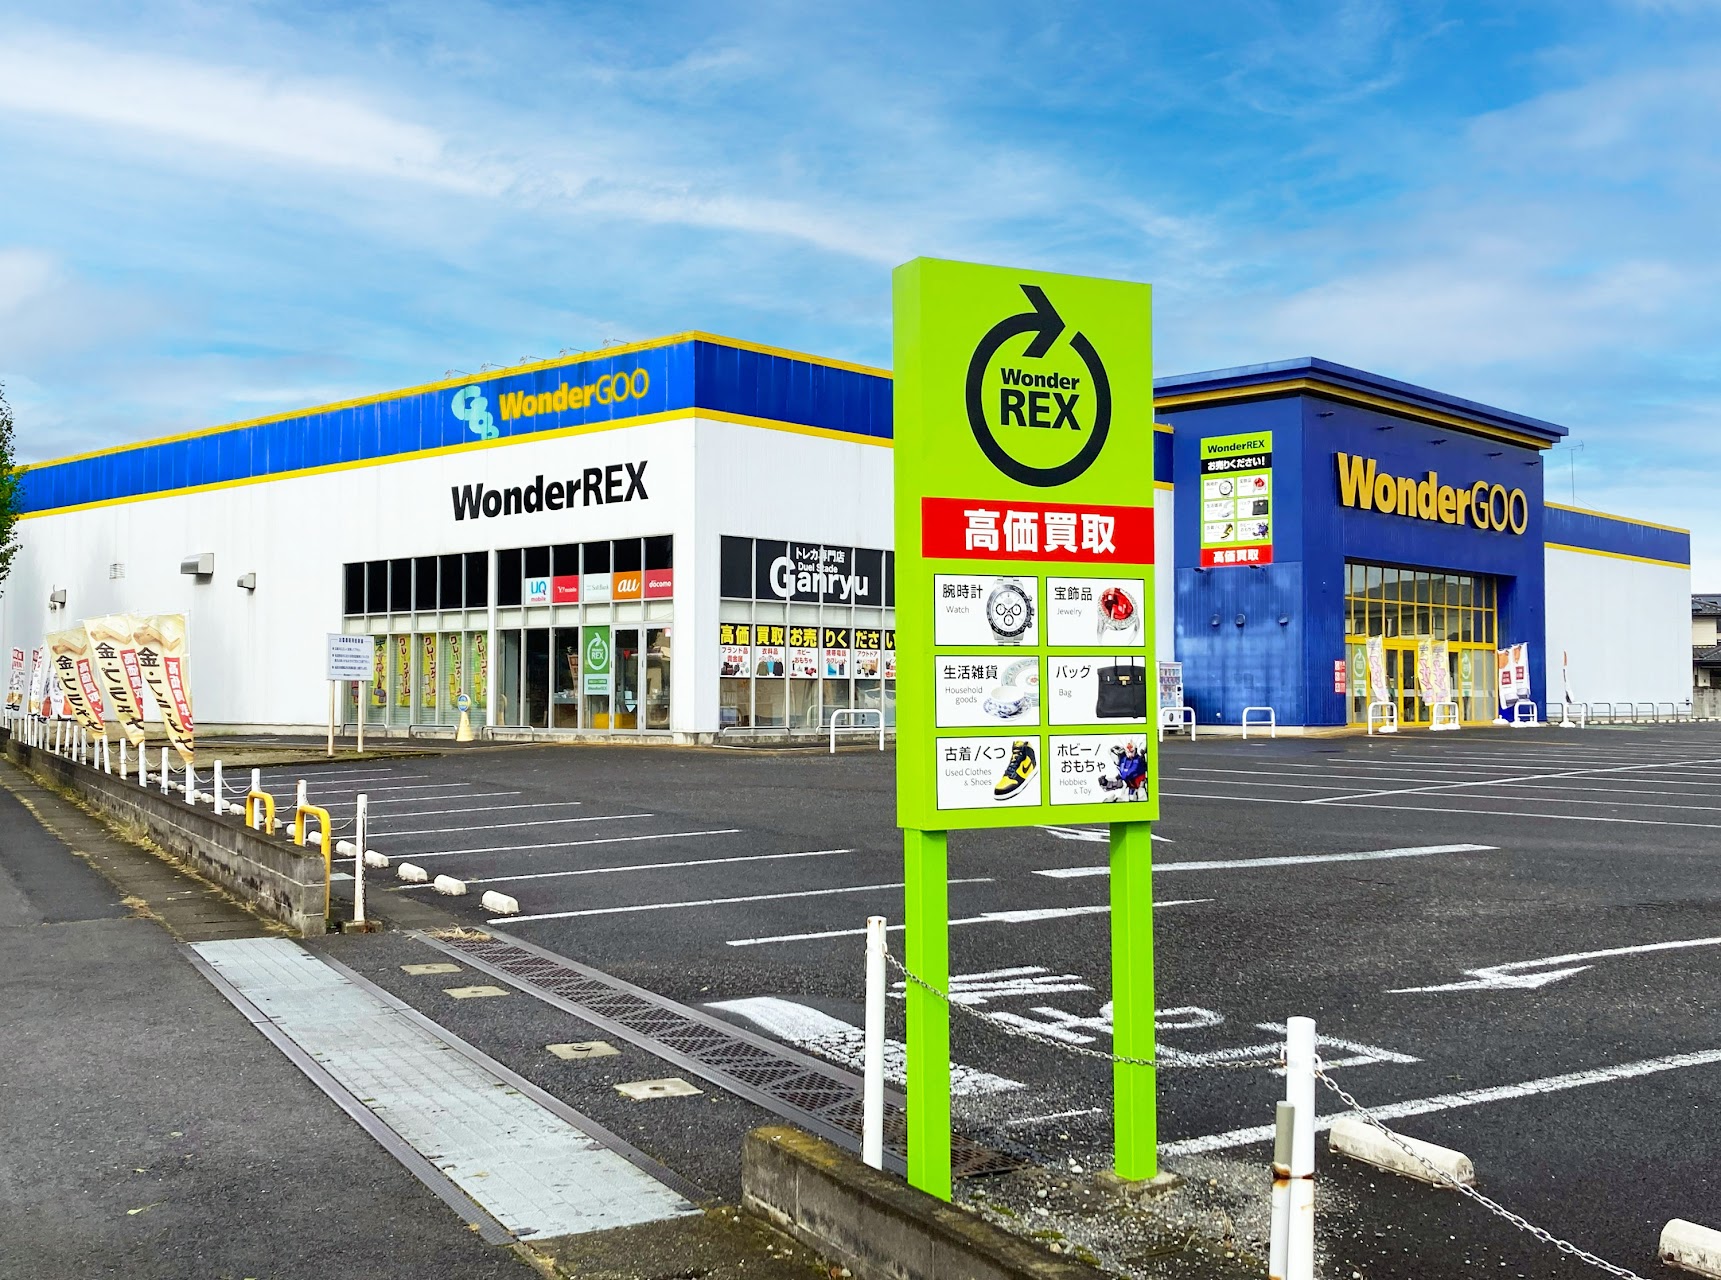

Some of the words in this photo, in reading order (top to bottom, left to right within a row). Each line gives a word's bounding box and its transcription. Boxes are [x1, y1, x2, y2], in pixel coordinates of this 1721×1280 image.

[1000, 368, 1080, 390] Wonder
[499, 368, 650, 421] WonderGOO
[1000, 389, 1081, 430] REX
[1208, 440, 1264, 453] WonderREX
[451, 460, 649, 521] WonderREX
[1336, 452, 1529, 536] WonderGOO
[964, 508, 1116, 554] 高価買取
[796, 547, 845, 563] トレカ専門店
[1213, 549, 1259, 563] 高価買取
[798, 562, 814, 572] Duel
[649, 580, 672, 588] docomo
[770, 556, 868, 600] Ganryu
[531, 581, 547, 596] UQ
[618, 579, 640, 592] au
[942, 584, 983, 598] 腕時計
[1054, 586, 1092, 600] 宝飾品
[946, 606, 970, 614] Watch
[1057, 608, 1082, 616] Jewelry
[592, 652, 604, 660] REX
[944, 665, 998, 680] 生活雑貨
[1056, 666, 1091, 679] バッグ
[945, 686, 982, 694] Household
[1058, 689, 1072, 698] Bag
[955, 696, 978, 705] goods
[964, 768, 992, 776] Clothes
[1061, 760, 1106, 773] おもちゃ
[970, 778, 992, 786] Shoes
[1080, 788, 1092, 796] Toy
